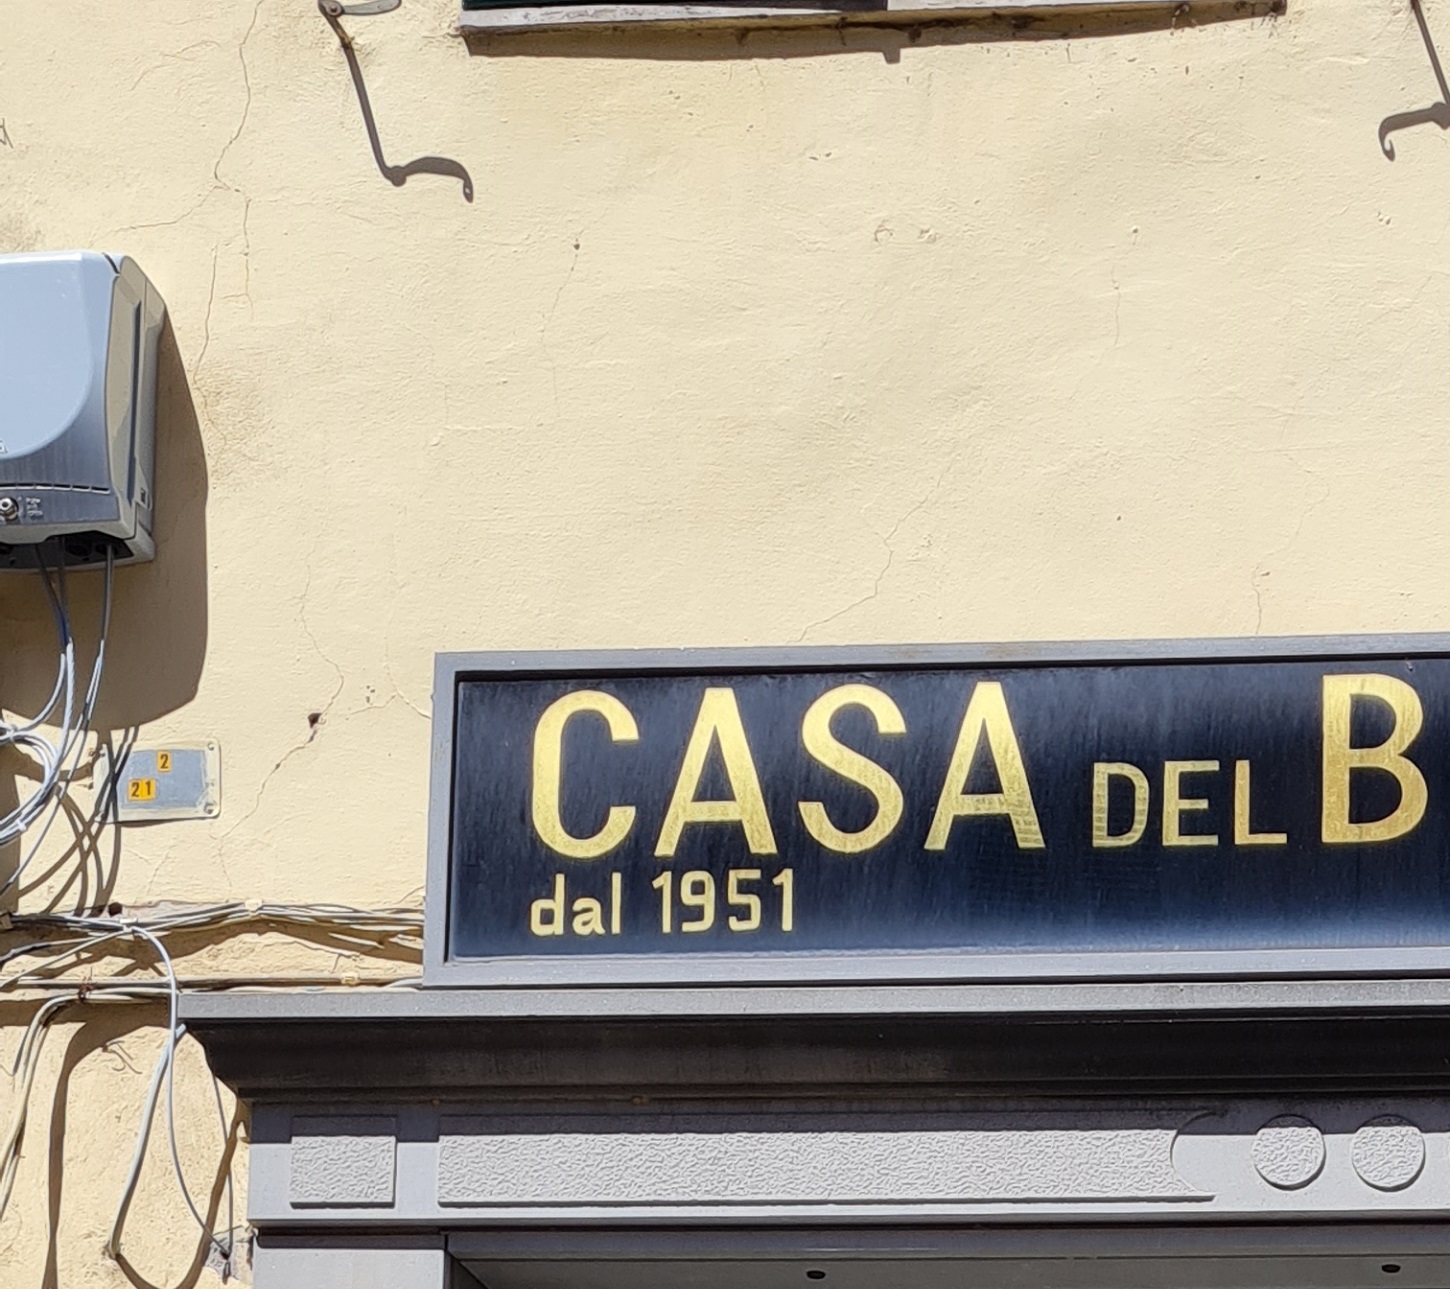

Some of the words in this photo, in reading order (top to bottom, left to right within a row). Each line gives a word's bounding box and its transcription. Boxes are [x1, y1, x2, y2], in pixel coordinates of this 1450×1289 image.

[159, 753, 169, 769] 2
[531, 680, 1047, 858] CASA
[1092, 759, 1289, 849] DEL
[529, 872, 622, 937] dal
[652, 867, 794, 934] 1951
